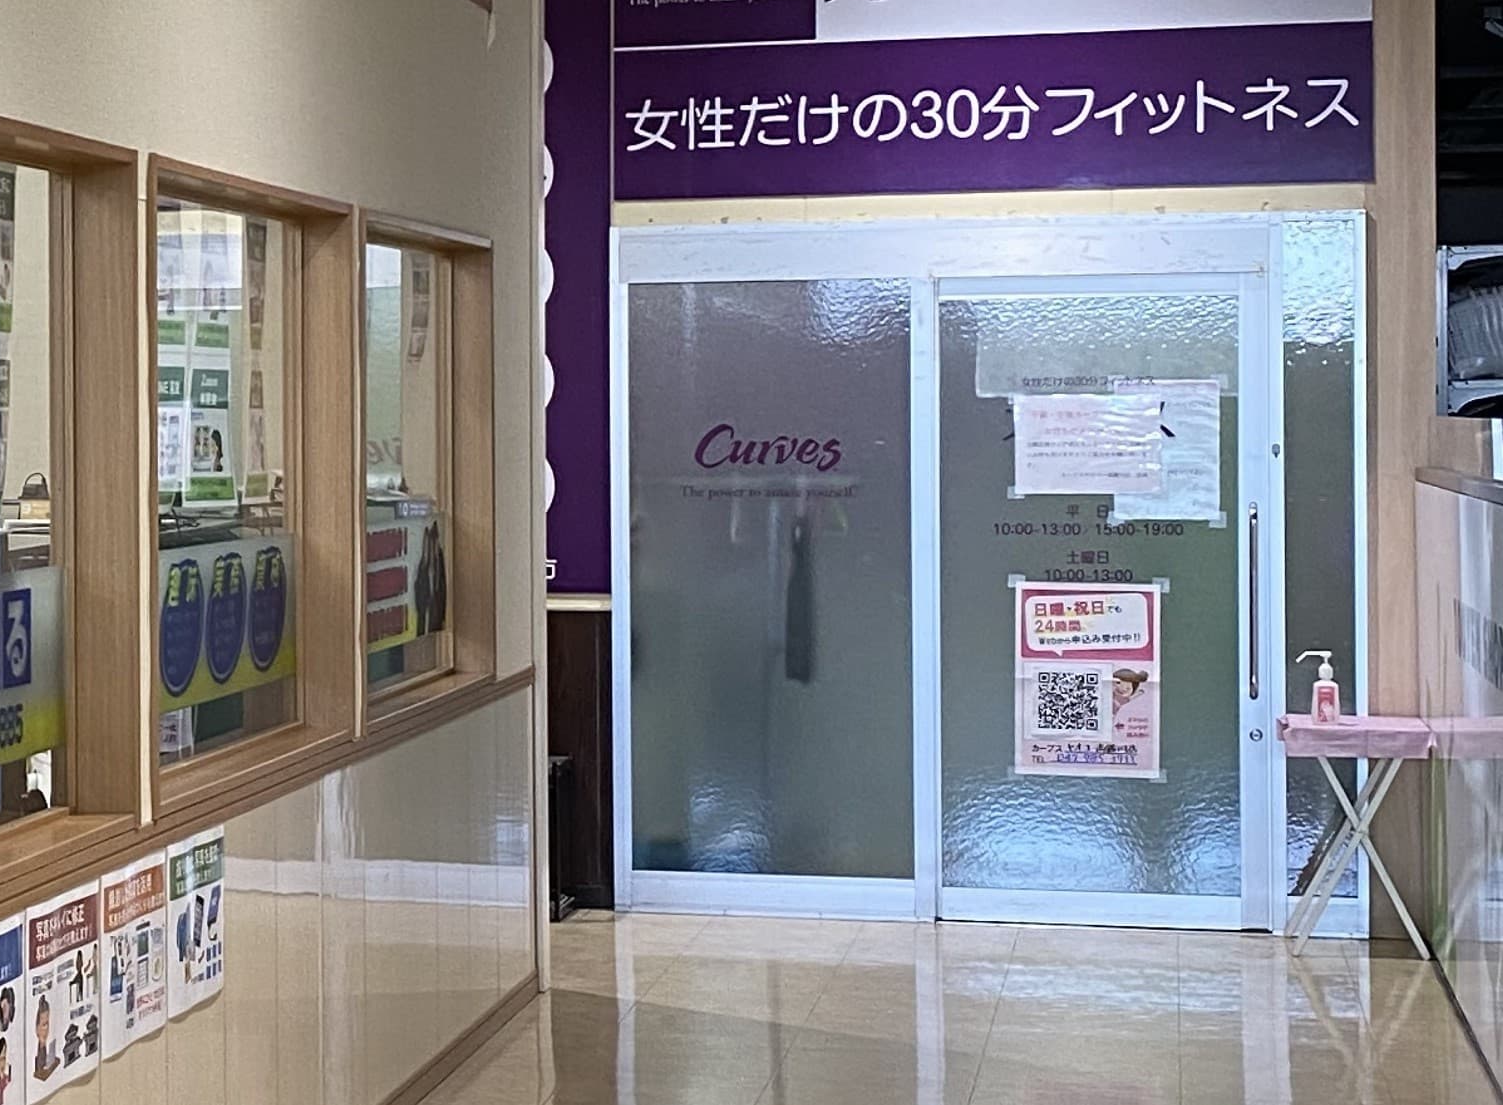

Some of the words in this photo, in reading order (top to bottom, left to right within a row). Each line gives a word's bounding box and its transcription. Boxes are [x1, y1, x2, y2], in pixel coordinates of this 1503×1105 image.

[625, 76, 1360, 153] 女性だけの30分フィットネス
[694, 423, 842, 472] Curves
[1066, 551, 1110, 564] 土曜日
[1045, 569, 1133, 582] 10:00-13:00
[1034, 619, 1082, 634] 24時間
